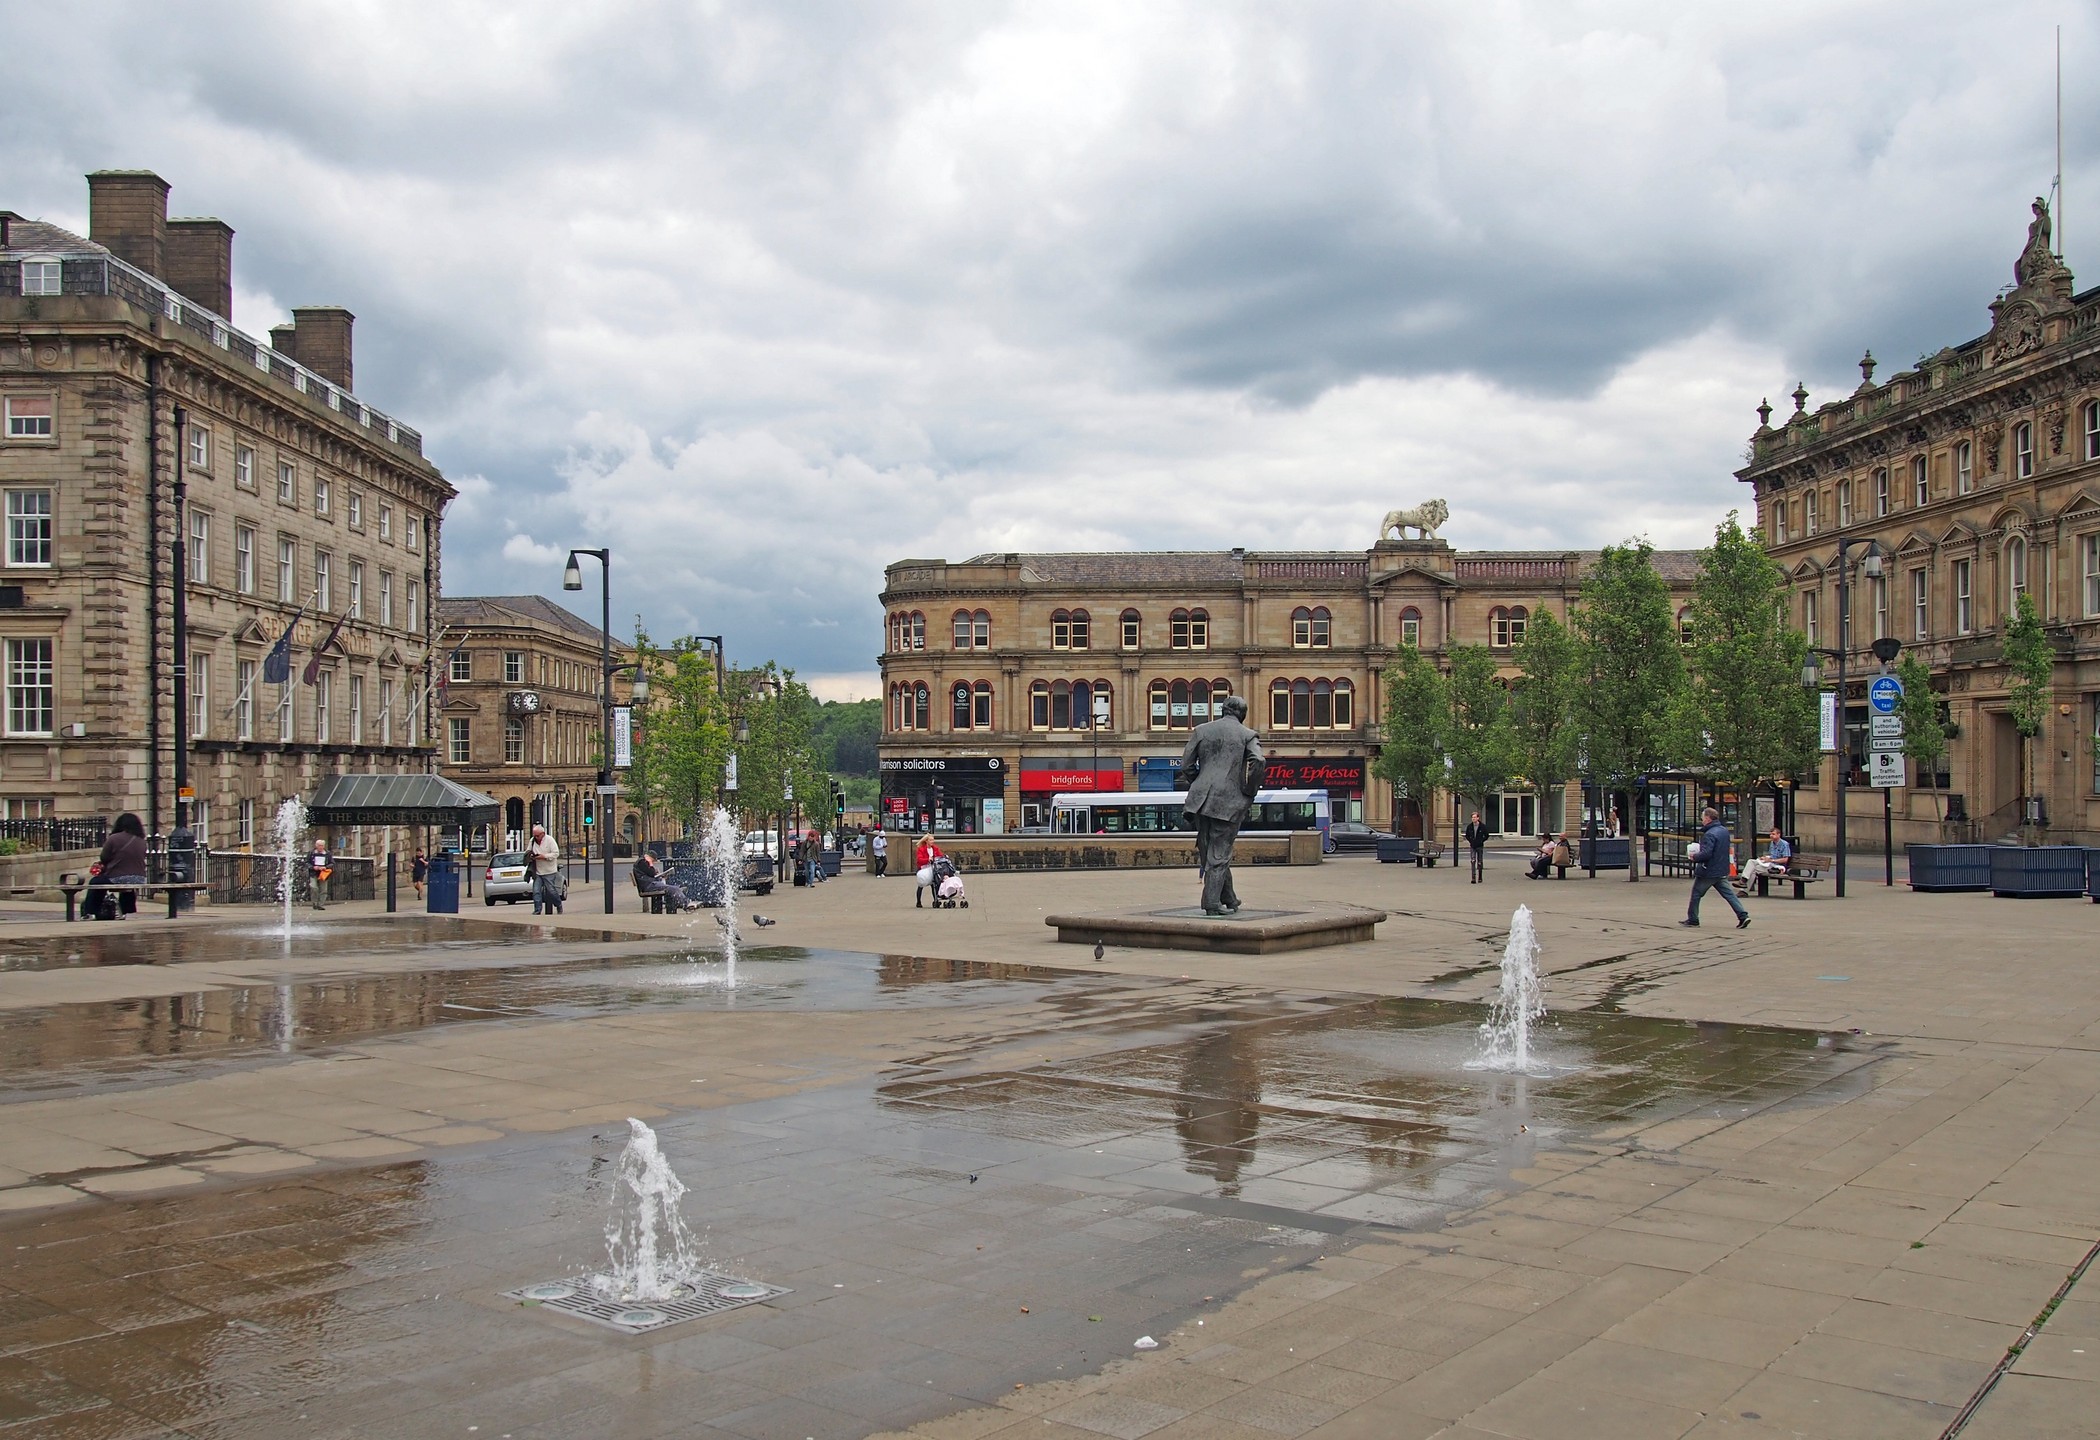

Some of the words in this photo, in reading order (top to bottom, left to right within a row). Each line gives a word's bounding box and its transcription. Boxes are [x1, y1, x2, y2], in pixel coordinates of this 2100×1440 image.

[262, 616, 312, 646] GEOGE
[342, 632, 372, 654] HOTEL
[903, 759, 946, 770] solicitors
[1264, 764, 1295, 779] The
[1300, 764, 1360, 783] Ephesus
[1051, 775, 1093, 786] bridgfords
[327, 812, 353, 822] THE
[357, 811, 408, 822] GEORGE
[411, 812, 450, 822] HOTEL
